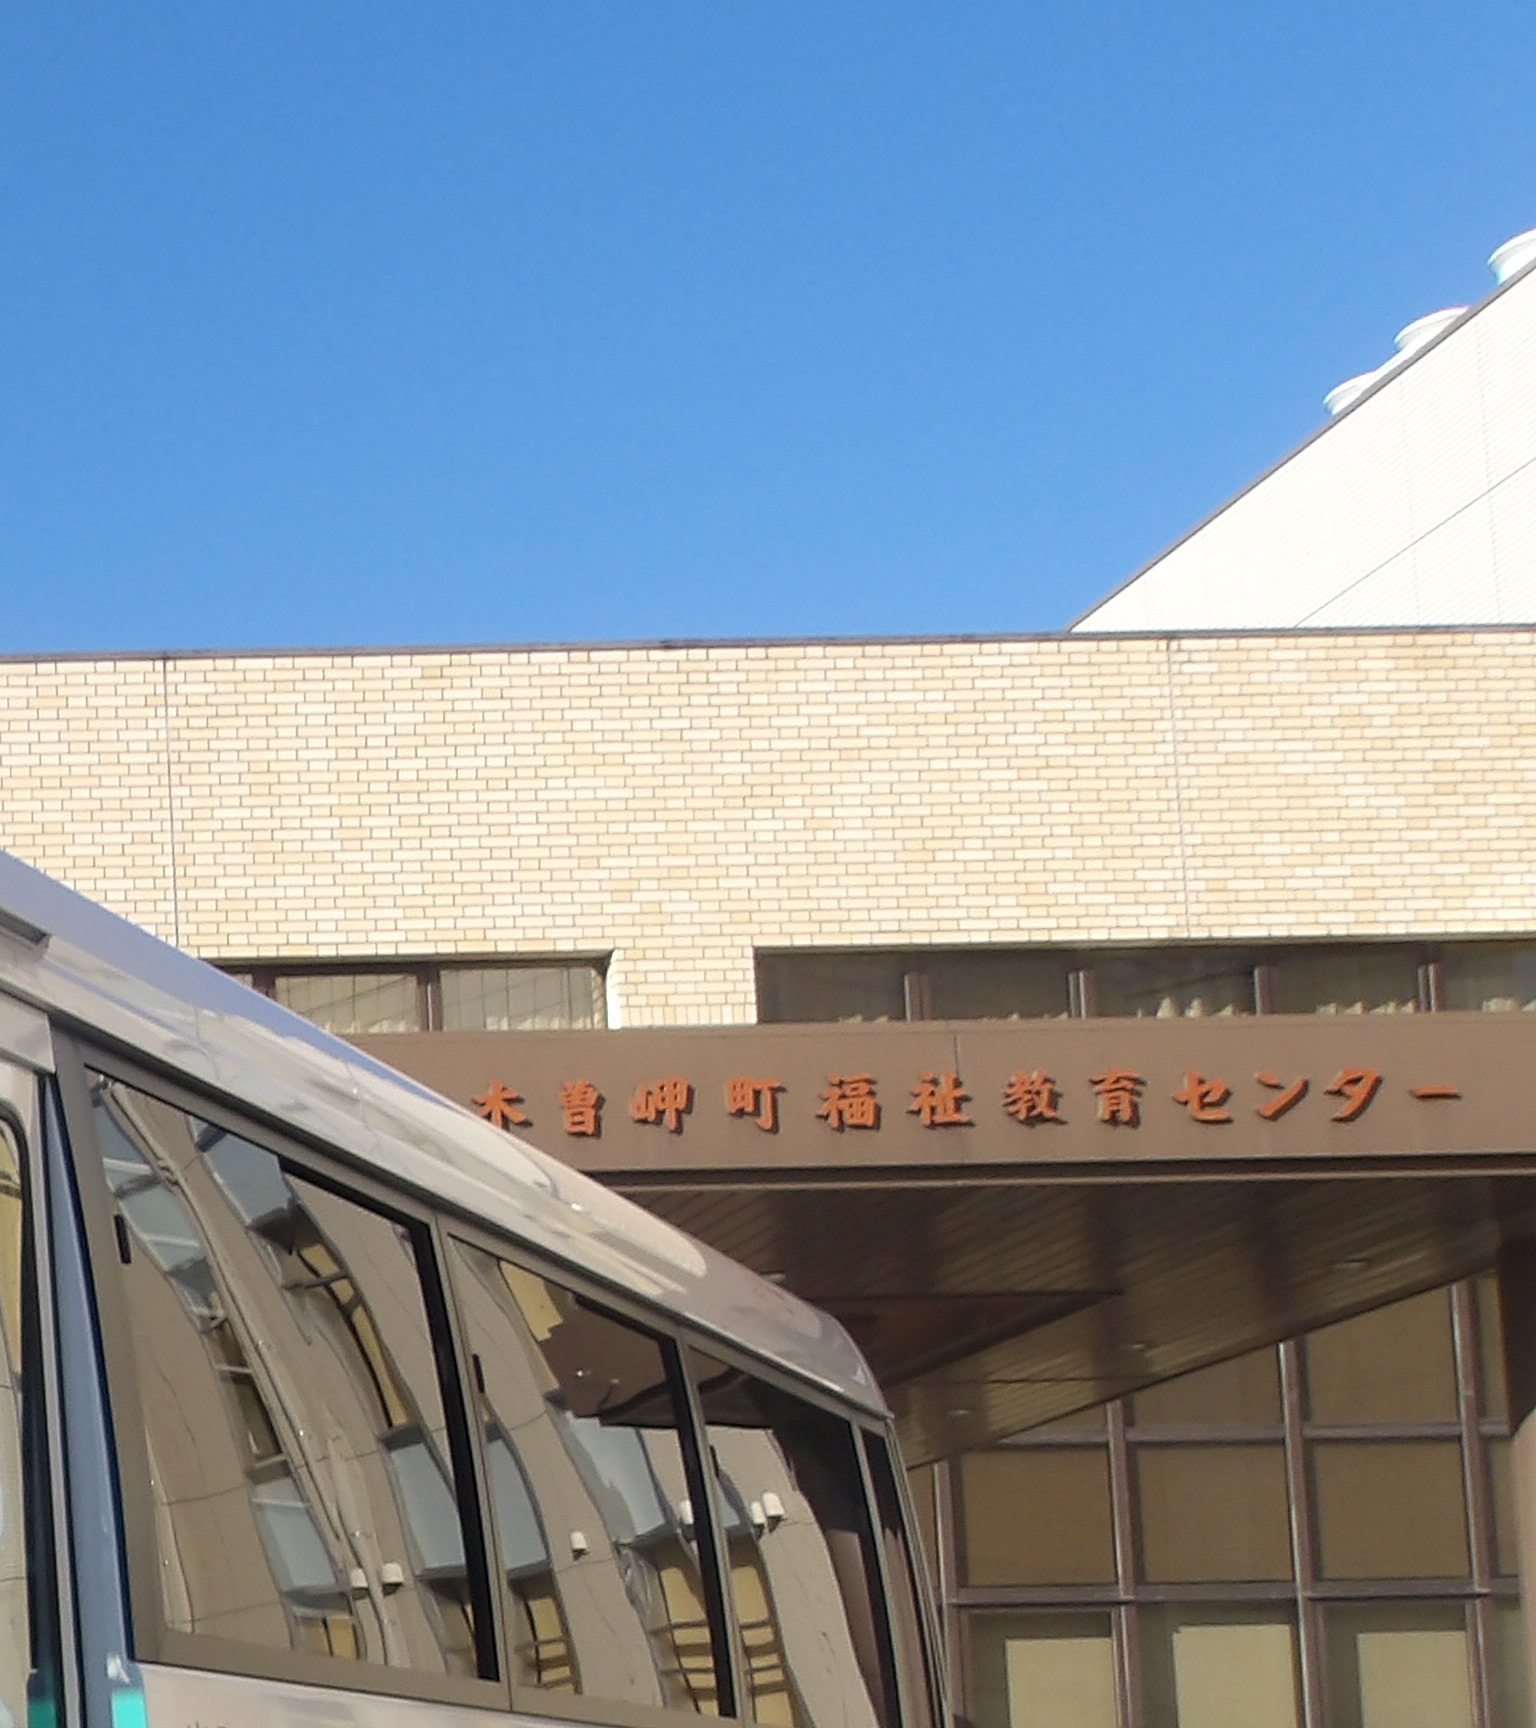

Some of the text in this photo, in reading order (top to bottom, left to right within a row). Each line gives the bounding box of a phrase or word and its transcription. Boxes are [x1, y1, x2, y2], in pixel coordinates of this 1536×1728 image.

[471, 1066, 1461, 1141] 木曽岬町福祉教育センター
